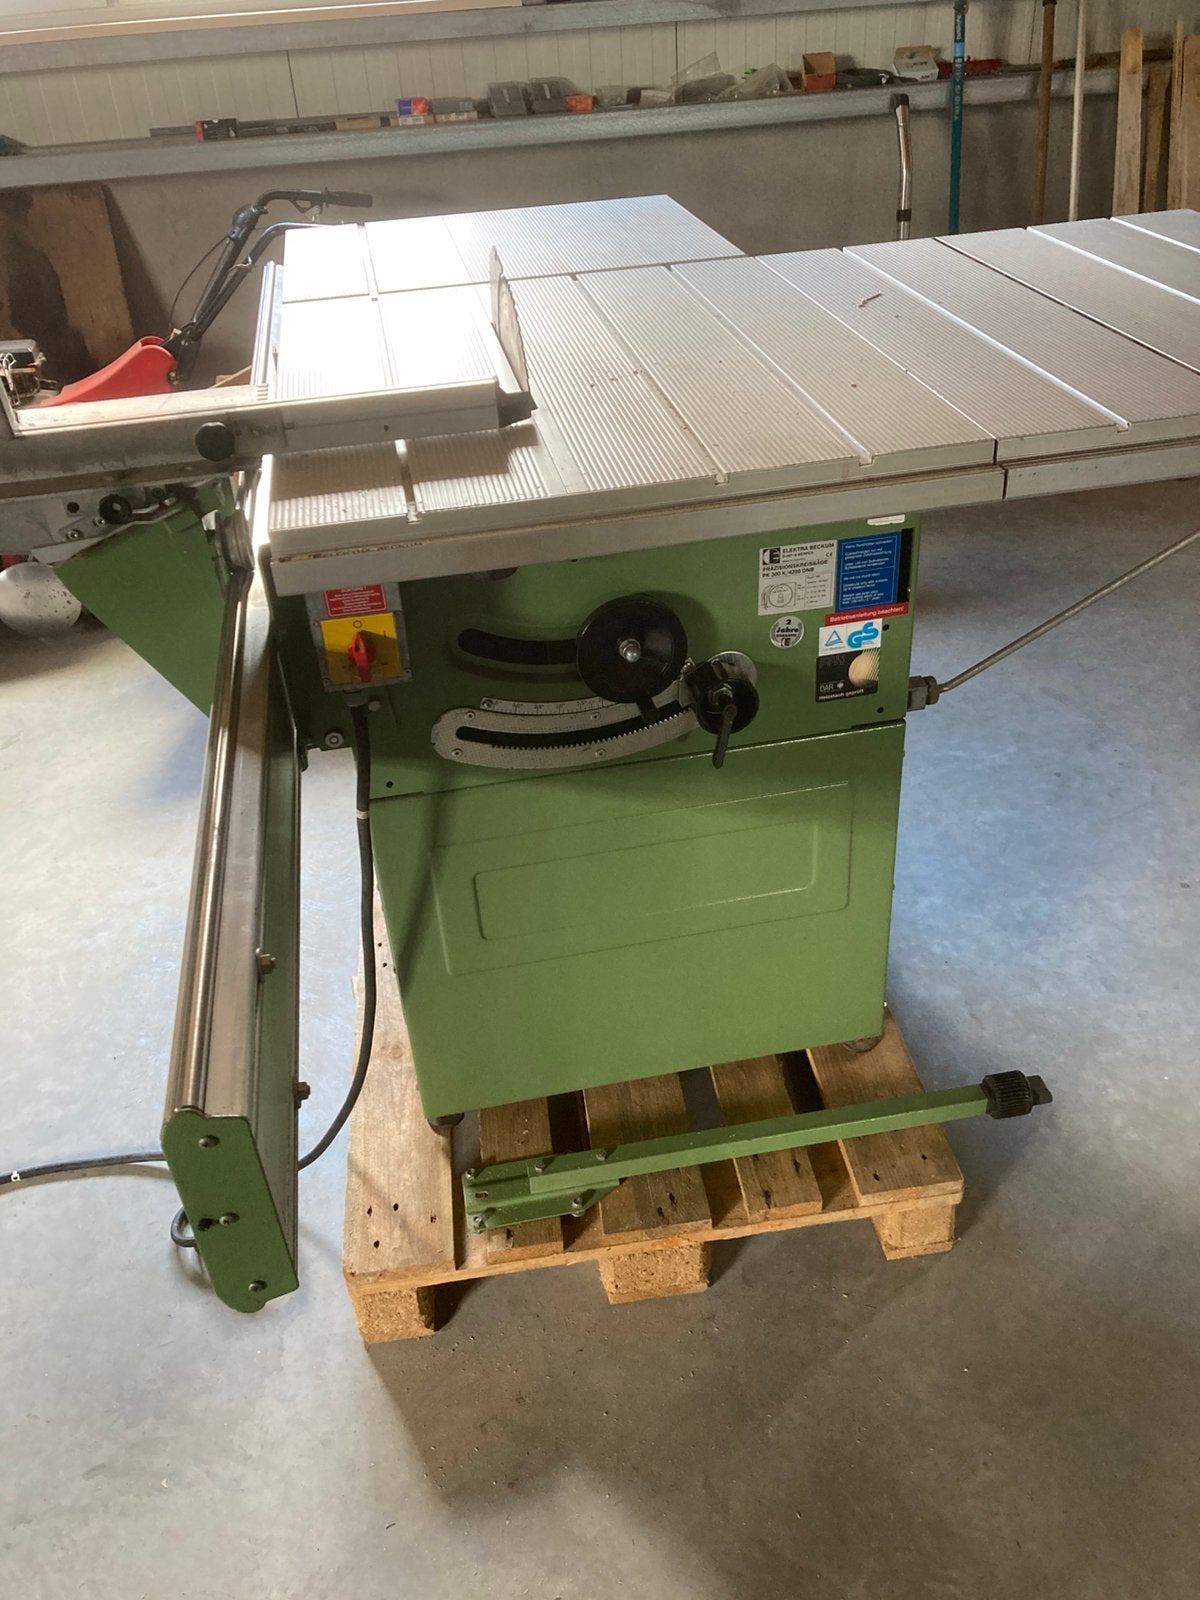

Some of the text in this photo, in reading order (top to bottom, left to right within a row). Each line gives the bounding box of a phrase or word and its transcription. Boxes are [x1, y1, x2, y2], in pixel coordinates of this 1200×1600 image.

[782, 546, 808, 554] ELEKTRA
[809, 542, 835, 551] BECKUM
[846, 621, 879, 649] GS
